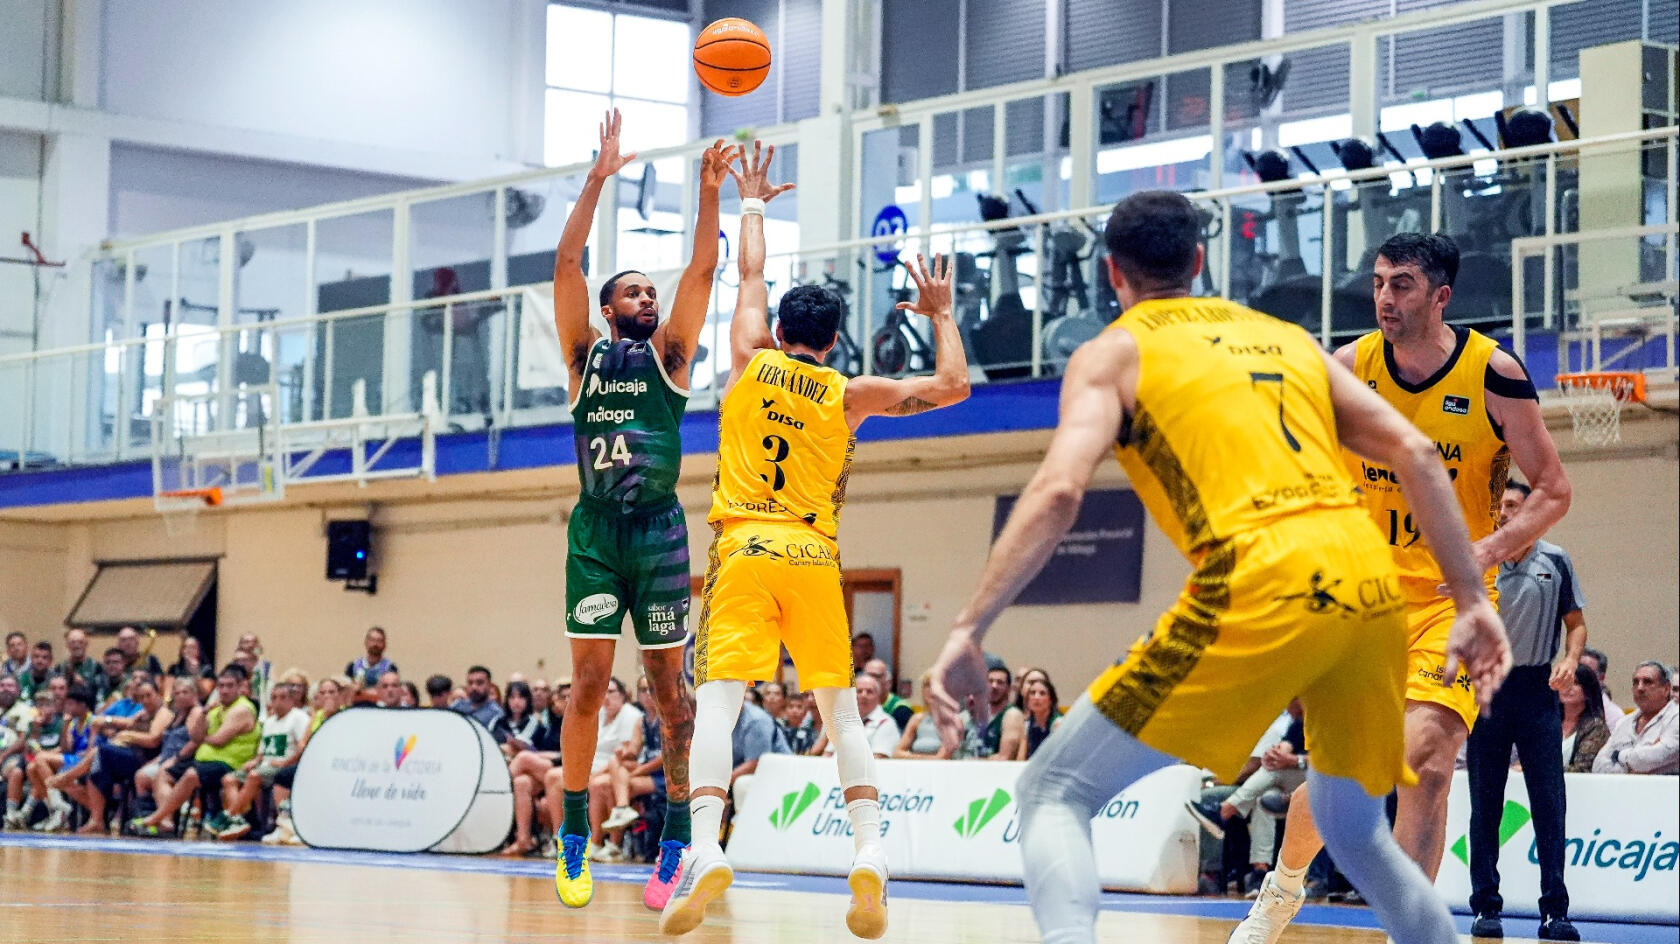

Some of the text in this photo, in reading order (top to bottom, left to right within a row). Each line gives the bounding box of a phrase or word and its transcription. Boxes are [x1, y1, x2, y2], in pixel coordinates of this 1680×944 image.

[756, 363, 829, 405] FERNÁNDEZ
[1249, 371, 1301, 453] 7
[590, 434, 632, 470] 24
[760, 434, 790, 492] 3
[1386, 509, 1421, 548] 19
[648, 603, 667, 611] sabor
[649, 619, 676, 636] laga
[824, 787, 934, 813] Fuación
[812, 812, 890, 837] Unica
